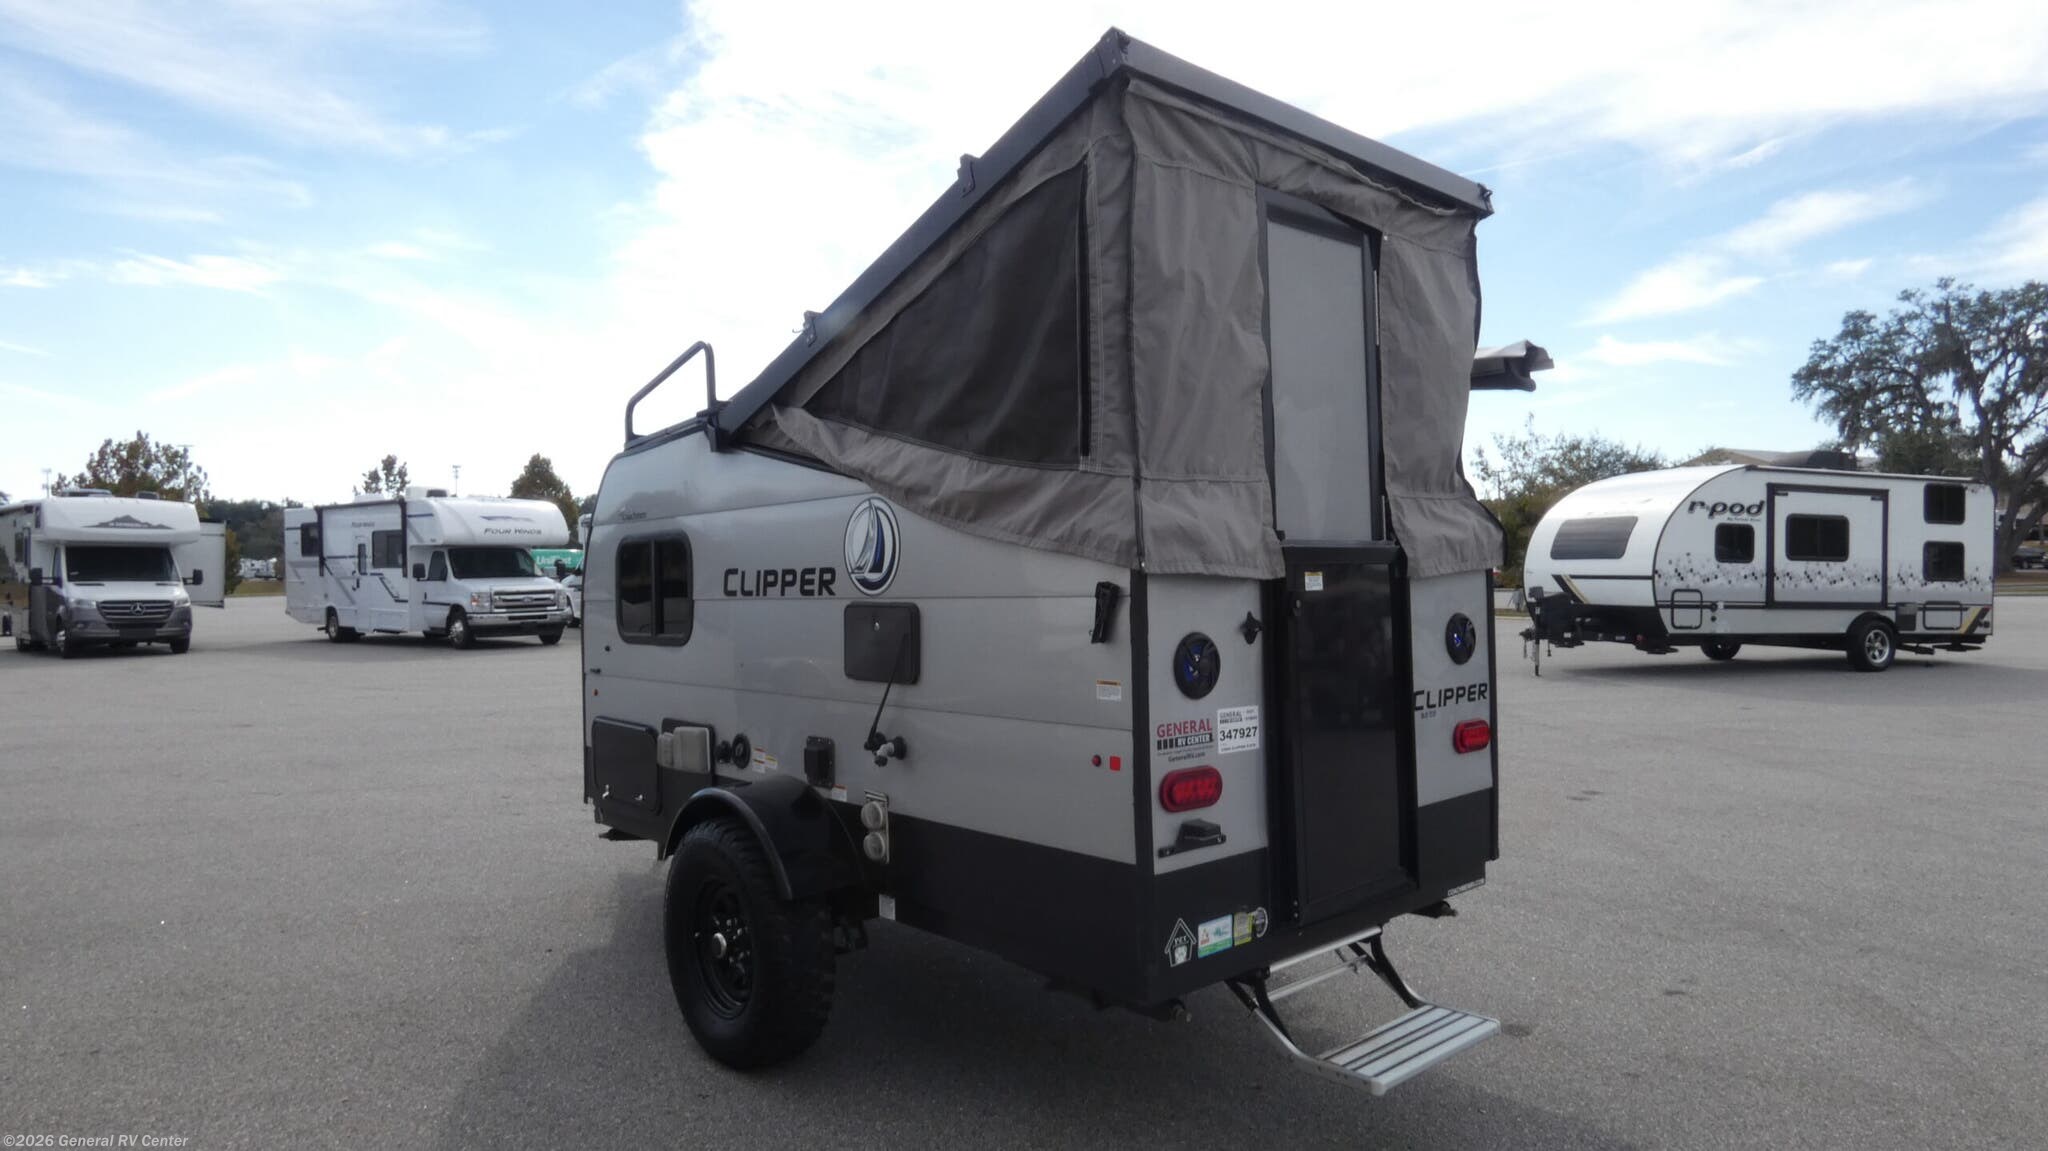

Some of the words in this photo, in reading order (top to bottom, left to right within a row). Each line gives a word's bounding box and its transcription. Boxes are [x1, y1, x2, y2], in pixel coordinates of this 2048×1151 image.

[723, 567, 836, 597] CLIPPER
[1414, 682, 1488, 711] CLIPPER
[1157, 718, 1212, 738] GENERAL
[1220, 726, 1258, 741] 347927
[1177, 736, 1188, 747] RV
[1188, 734, 1210, 745] CENTER
